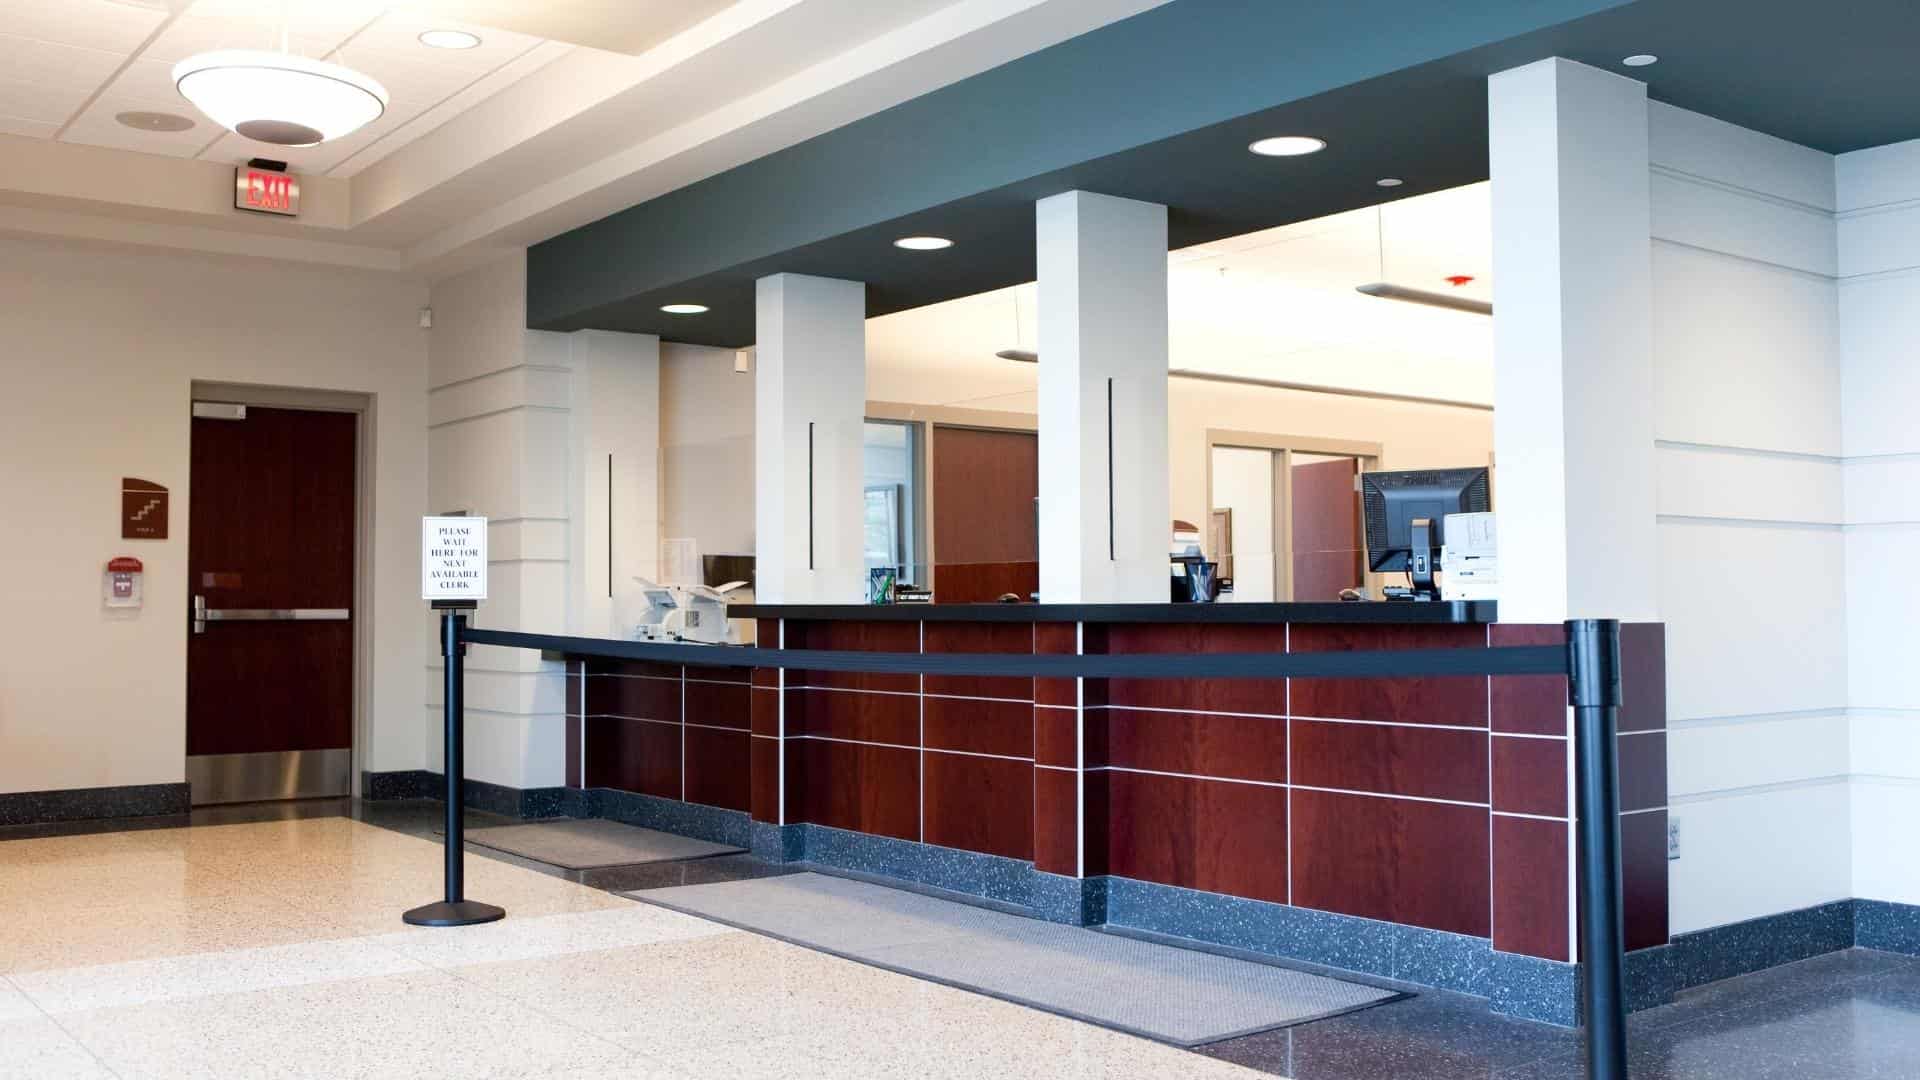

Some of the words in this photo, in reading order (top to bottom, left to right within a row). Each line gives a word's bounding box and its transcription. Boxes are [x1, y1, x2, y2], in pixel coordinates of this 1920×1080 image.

[248, 173, 294, 208] EXIT
[439, 527, 472, 535] PLEASE
[443, 538, 467, 546] WAIT
[431, 549, 454, 557] HERE
[460, 549, 478, 557] FOR
[431, 570, 478, 578] AVAILABLE
[440, 581, 470, 589] CLERK
